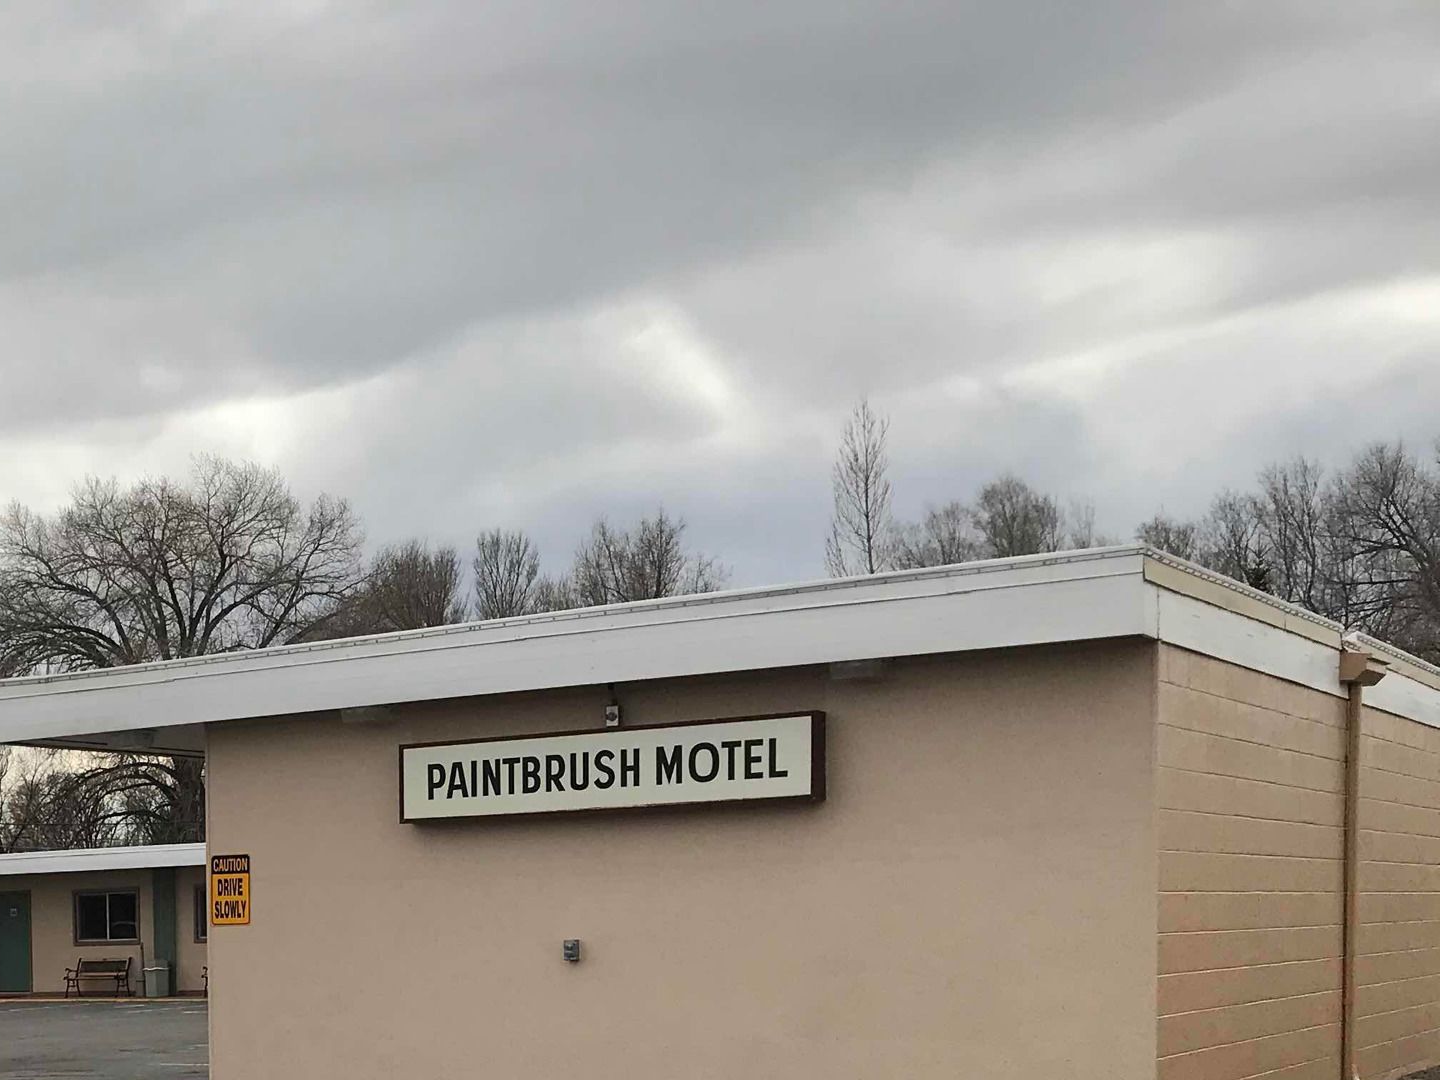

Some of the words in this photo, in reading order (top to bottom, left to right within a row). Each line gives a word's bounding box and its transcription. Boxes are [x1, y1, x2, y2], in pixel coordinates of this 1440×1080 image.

[427, 748, 641, 801] PAINTBRUSH
[656, 738, 789, 786] MOTEL
[213, 858, 248, 871] CAUTION
[217, 878, 243, 896] DRIVE
[214, 900, 246, 918] SLOWLY
